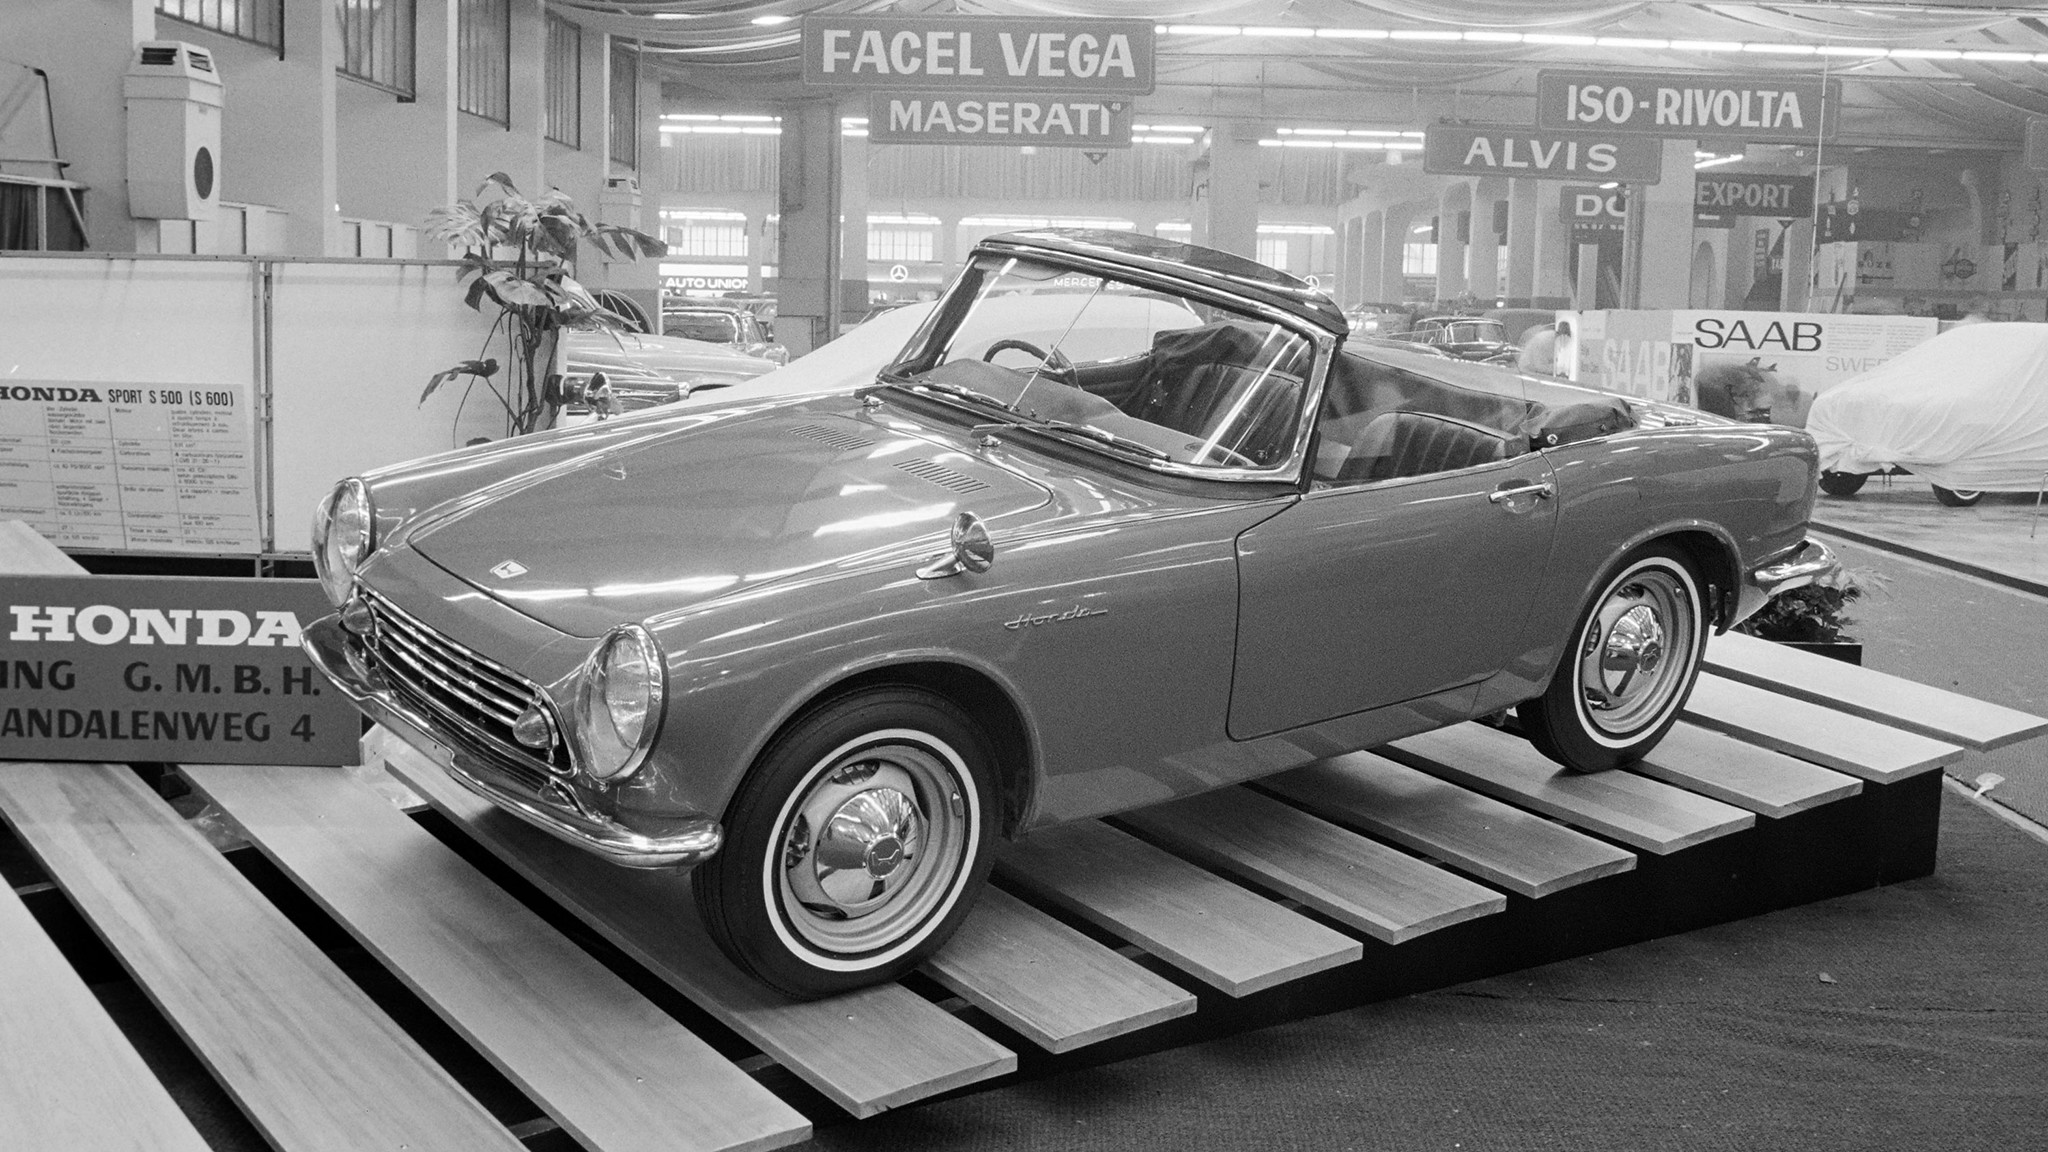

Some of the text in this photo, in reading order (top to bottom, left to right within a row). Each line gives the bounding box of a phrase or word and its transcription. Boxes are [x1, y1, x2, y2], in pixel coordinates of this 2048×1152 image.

[823, 29, 1136, 78] FACEL VEGA
[889, 100, 1110, 136] MASERATI
[1463, 136, 1618, 173] ALVIS
[1696, 181, 1794, 208] EXPORT
[665, 277, 706, 288] AUTO
[1694, 318, 1823, 351] SAAB
[109, 388, 143, 404] SPORT
[149, 390, 157, 404] S
[160, 390, 183, 405] 500
[189, 390, 202, 406] (S
[205, 390, 234, 407] 600)
[10, 604, 302, 648] HONDA
[0, 707, 316, 742] ANDALENWEG 4
